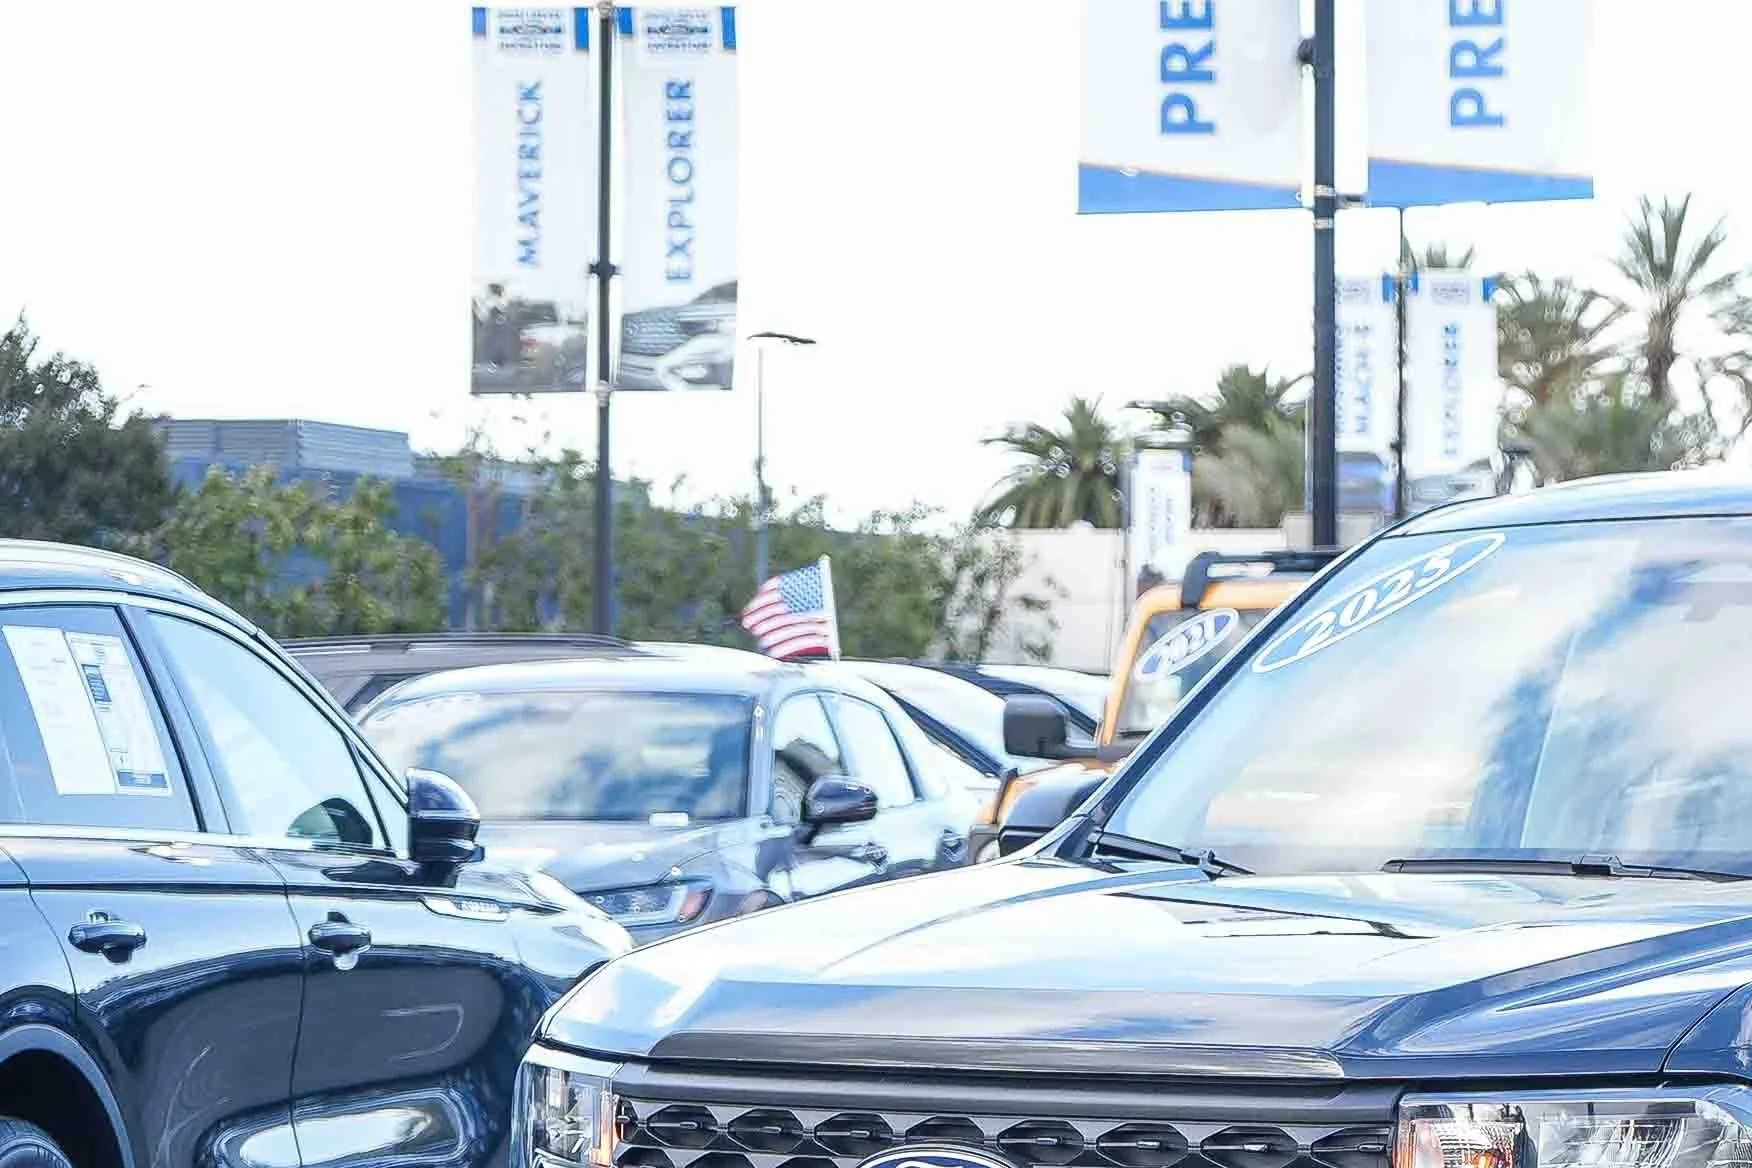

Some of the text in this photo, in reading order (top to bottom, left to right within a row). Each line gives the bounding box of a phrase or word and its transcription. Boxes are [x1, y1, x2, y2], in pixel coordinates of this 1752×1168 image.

[517, 80, 542, 267] MAVERICK
[666, 78, 693, 281] EXPLORER
[1300, 551, 1456, 643] 2025
